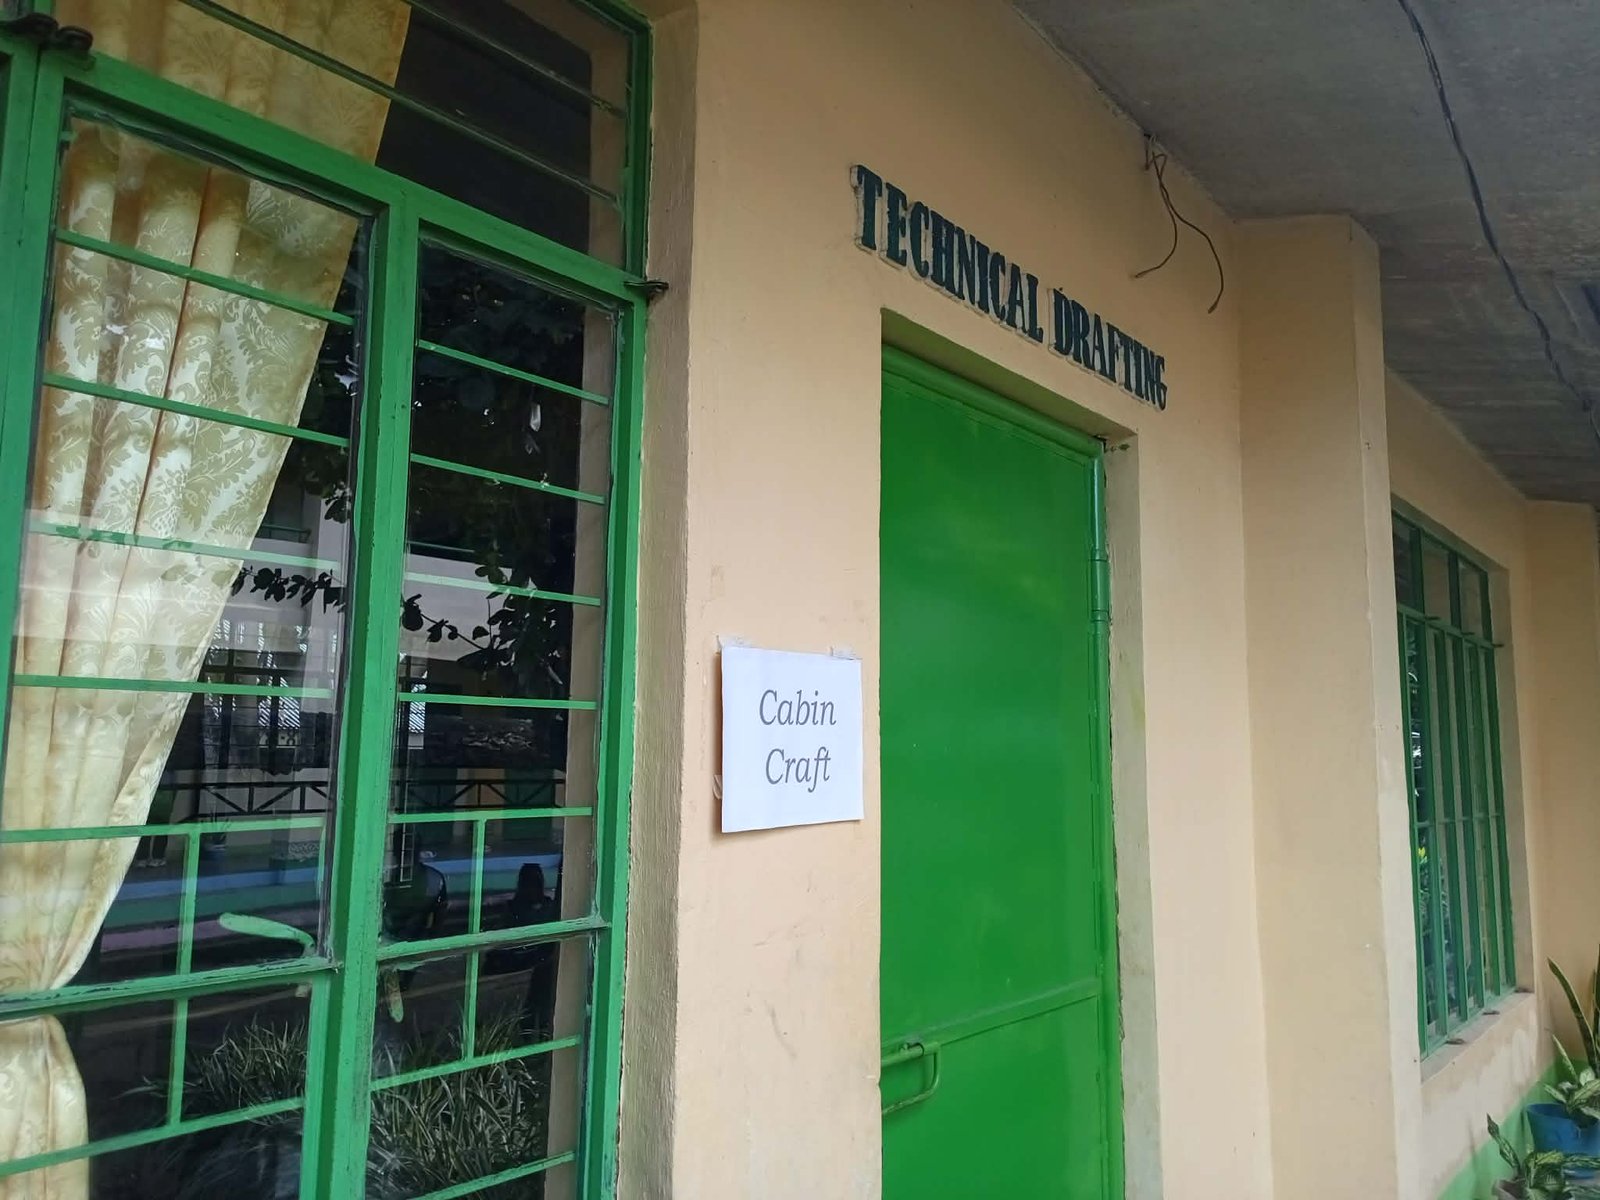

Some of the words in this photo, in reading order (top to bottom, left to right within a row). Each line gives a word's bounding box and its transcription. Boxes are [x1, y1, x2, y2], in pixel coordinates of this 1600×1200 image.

[853, 164, 1043, 343] TECHNICAL
[1052, 288, 1167, 411] DRAFTING
[759, 689, 837, 726] Cabin
[765, 746, 831, 793] Craft
